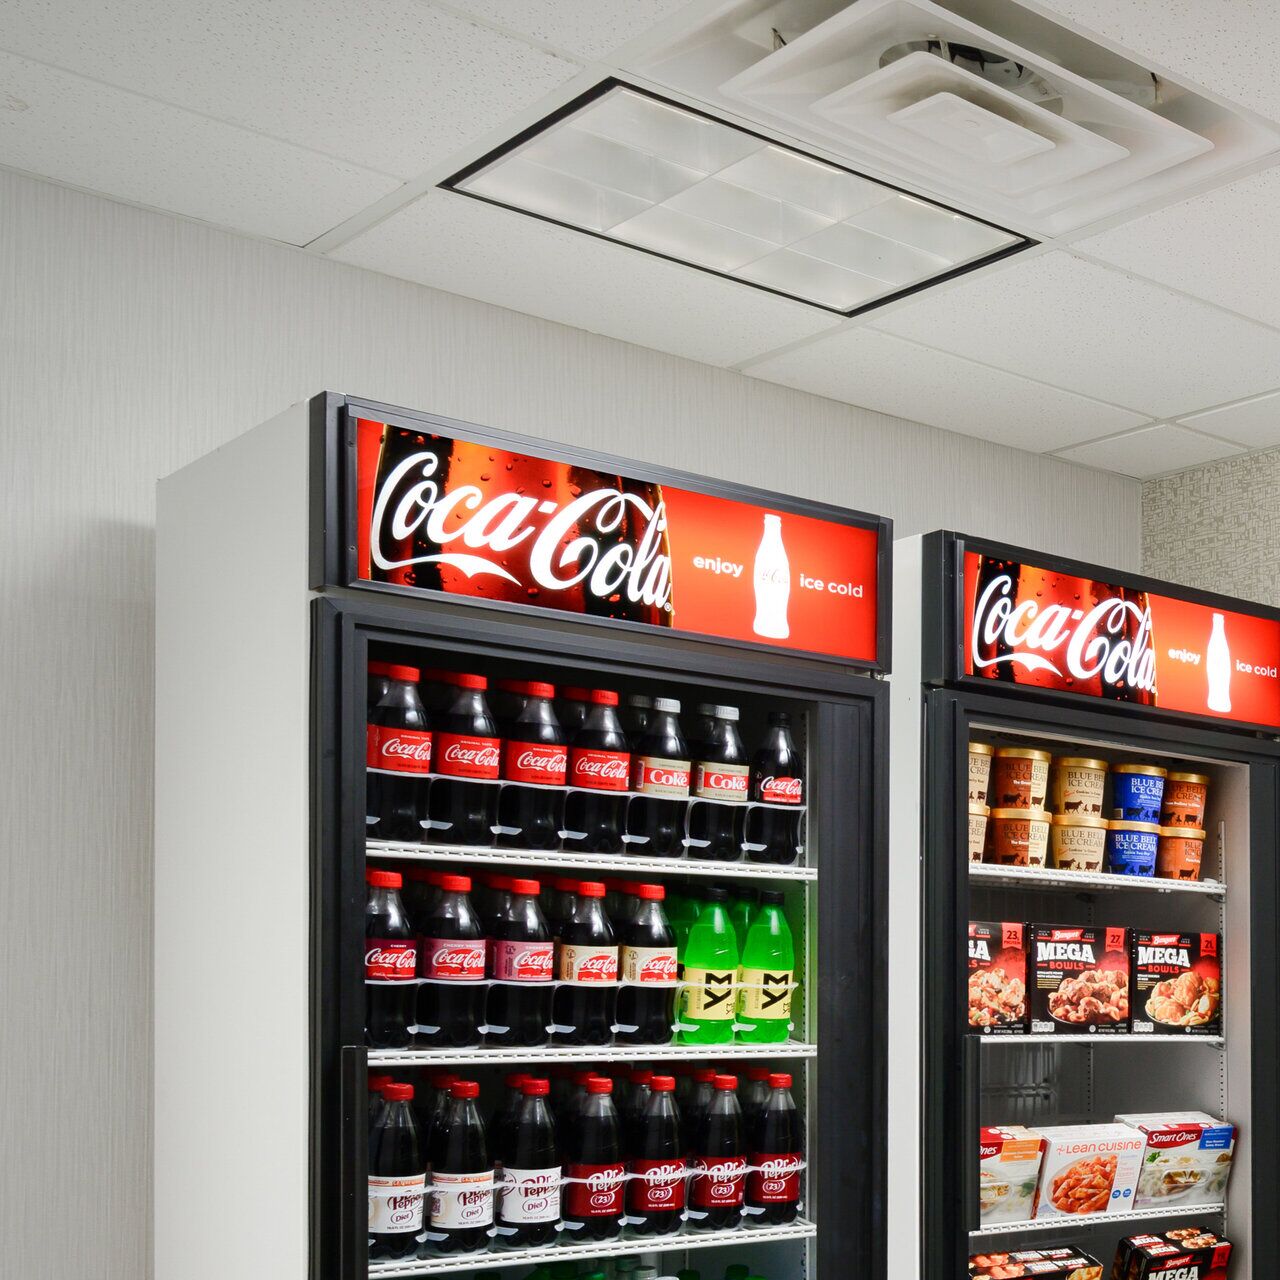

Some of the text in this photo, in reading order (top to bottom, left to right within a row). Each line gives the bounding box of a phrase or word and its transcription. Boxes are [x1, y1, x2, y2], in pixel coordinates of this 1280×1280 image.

[371, 451, 673, 609] Coca-Cola
[693, 553, 743, 578] enjoy
[800, 573, 863, 598] ice cold
[972, 575, 1156, 692] Coca-Cola
[1168, 648, 1200, 665] enjoy
[1236, 660, 1277, 678] ice cold
[575, 757, 627, 778] Coca-Cola
[650, 769, 688, 787] Coke
[710, 774, 746, 791] Coke
[1068, 779, 1082, 787] ICE
[1131, 778, 1153, 786] BLUE
[1131, 785, 1144, 793] ICE
[1061, 830, 1104, 840] BLUE BELL
[1115, 834, 1157, 844] BLUE BELL
[1061, 837, 1103, 848] ICE CREAM
[1116, 841, 1157, 850] ICE CREAM
[1006, 930, 1017, 940] 23
[1110, 934, 1120, 944] 27
[1036, 940, 1096, 964] MEGA
[1137, 946, 1190, 967] MEGA
[1050, 962, 1084, 970] BOWLS
[1148, 965, 1179, 974] BOWLS
[1150, 1131, 1198, 1144] Smart Ones
[1065, 1139, 1142, 1154] Lean cuisine
[717, 1185, 728, 1195] 23
[768, 1181, 779, 1191] 23
[654, 1189, 665, 1198] 23
[598, 1195, 609, 1204] 23
[527, 1202, 543, 1211] Diet
[395, 1213, 411, 1222] Diet
[466, 1208, 480, 1217] Diet
